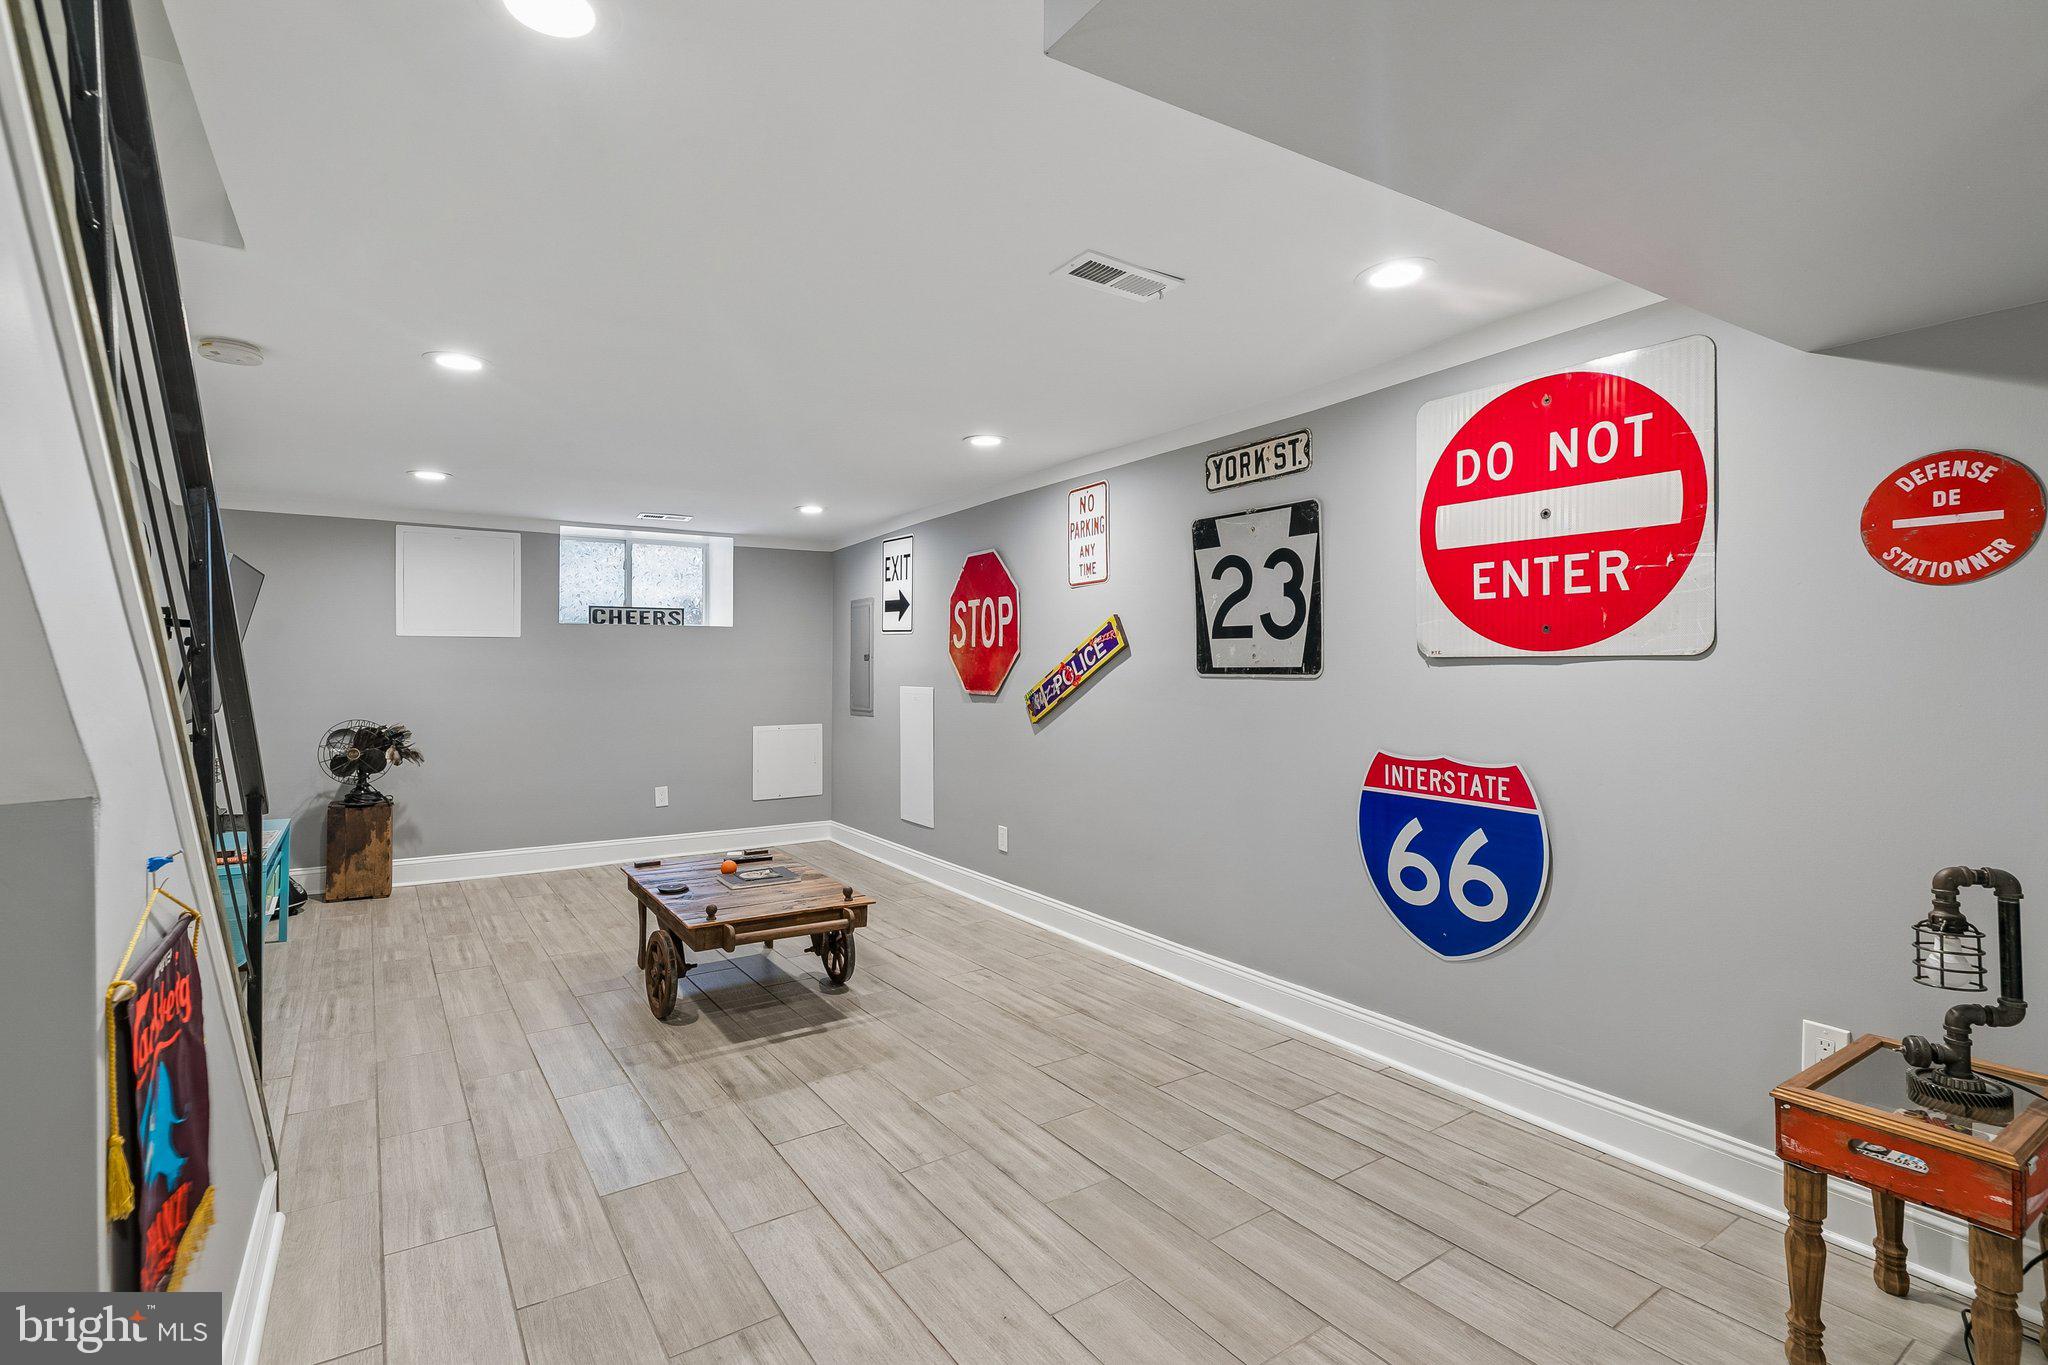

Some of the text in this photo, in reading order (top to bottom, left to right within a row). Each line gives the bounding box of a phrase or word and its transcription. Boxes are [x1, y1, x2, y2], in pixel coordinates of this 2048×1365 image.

[1212, 437, 1302, 485] YORK ST.
[1456, 412, 1654, 488] DO NOT
[1895, 459, 2000, 493] DEFENSE
[1079, 493, 1095, 515] NO
[1932, 488, 1961, 508] DE
[1069, 515, 1105, 541] PARKING
[884, 553, 911, 582] EXIT
[1078, 561, 1097, 577] TIME
[1079, 542, 1096, 558] ANY
[1882, 538, 2016, 578] STATIONNER
[1211, 547, 1307, 641] 23
[1473, 549, 1631, 600] ENTER
[591, 608, 682, 627] CHEERS
[952, 596, 1014, 649] STOP
[1052, 641, 1108, 695] POLICE
[1384, 763, 1511, 802] INTERSTATE
[1387, 817, 1509, 923] 66
